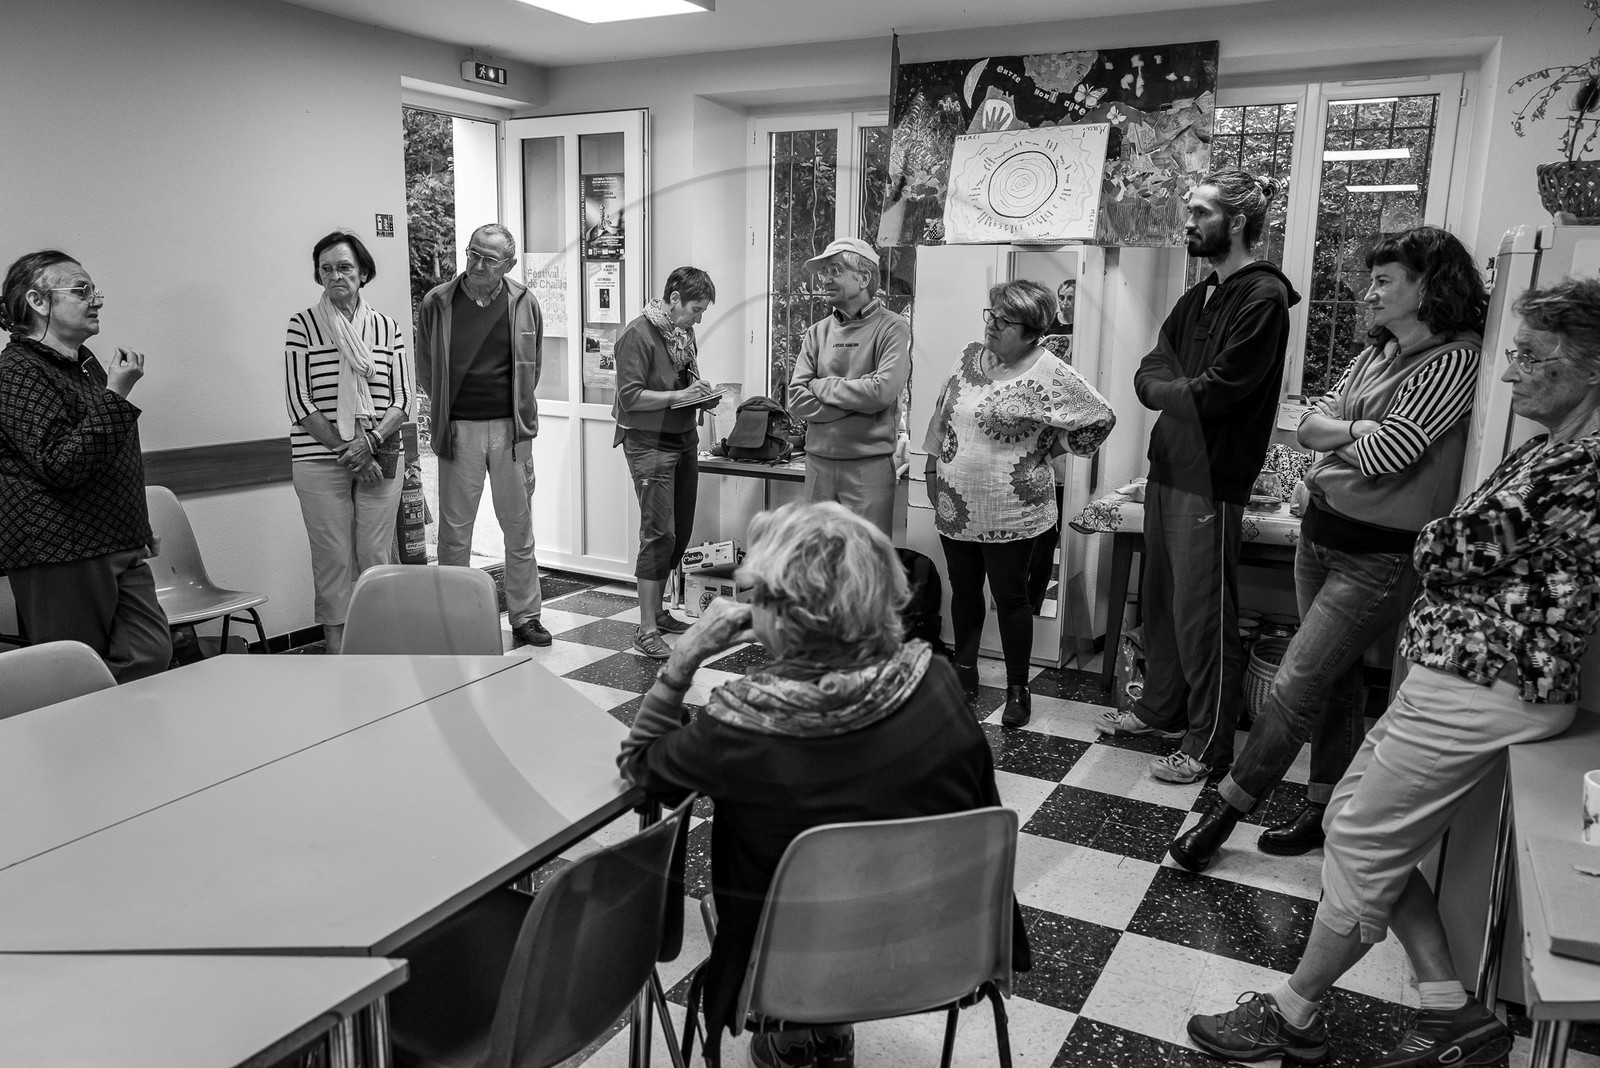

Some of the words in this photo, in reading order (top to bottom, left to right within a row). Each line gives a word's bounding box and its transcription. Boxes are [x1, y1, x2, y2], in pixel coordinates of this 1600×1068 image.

[956, 134, 981, 142] MERCI
[1087, 208, 1096, 232] MERCI
[527, 266, 559, 279] Festival
[527, 279, 537, 289] de
